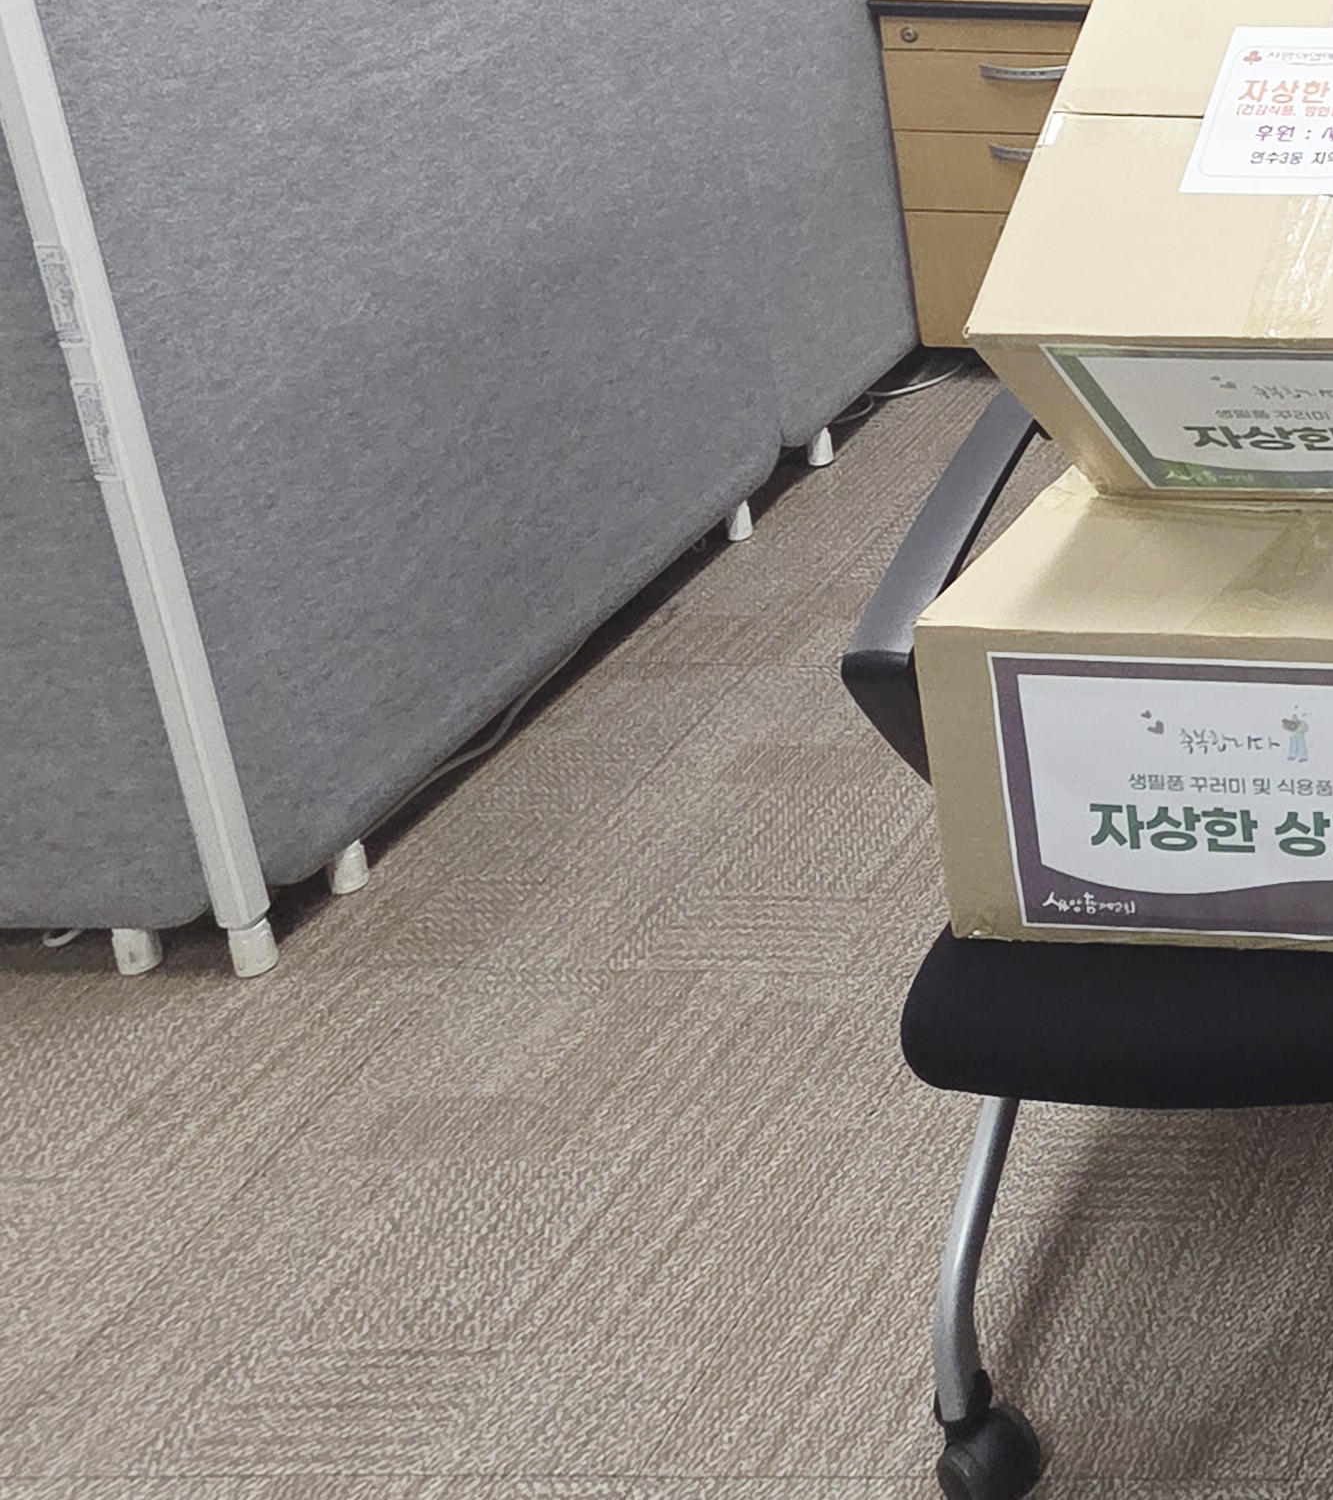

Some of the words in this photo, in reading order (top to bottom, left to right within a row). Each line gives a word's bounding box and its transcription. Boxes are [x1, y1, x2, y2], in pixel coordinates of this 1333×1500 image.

[1238, 80, 1330, 104] 자상한
[1251, 151, 1303, 164] 연수3동
[1128, 772, 1184, 793] 생필품
[1189, 775, 1246, 795] 꾸러미
[1252, 777, 1270, 796] 및
[1276, 778, 1333, 797] 식용품
[1089, 802, 1258, 853] 자상한
